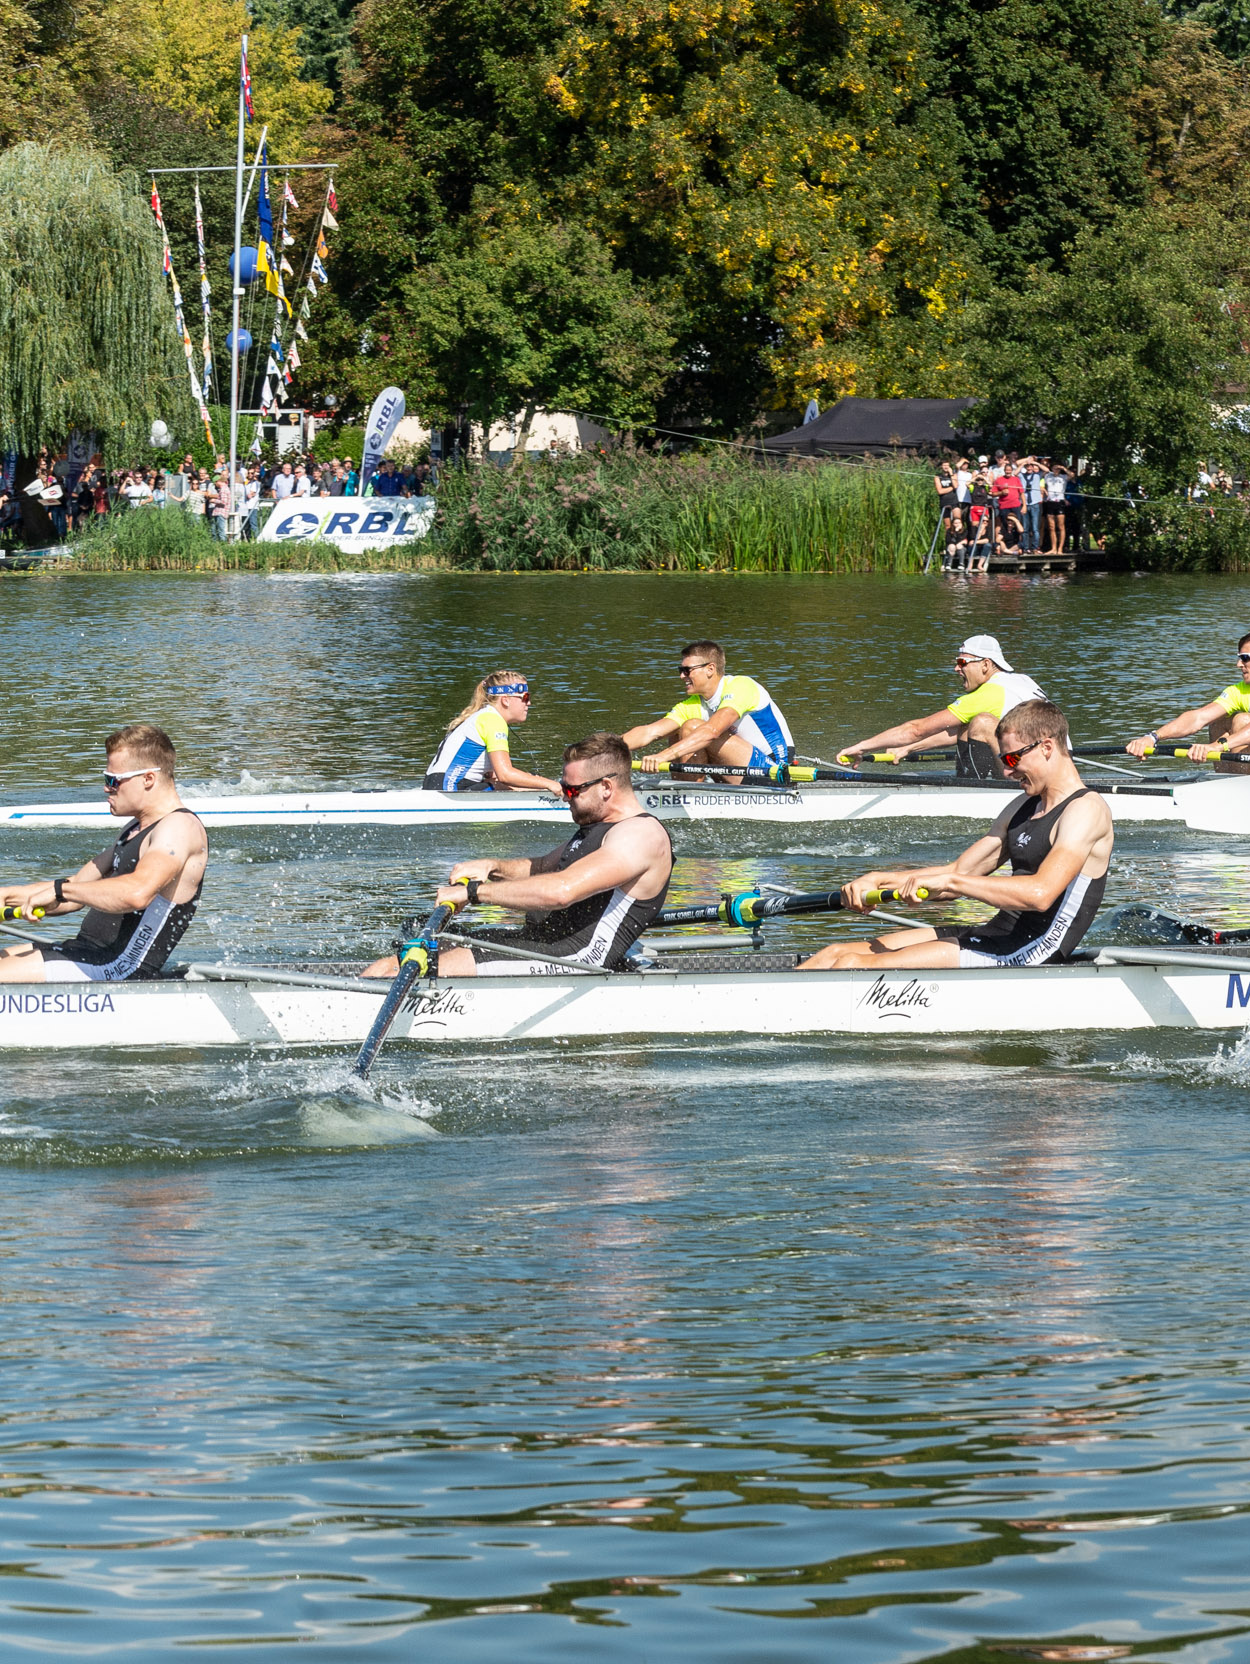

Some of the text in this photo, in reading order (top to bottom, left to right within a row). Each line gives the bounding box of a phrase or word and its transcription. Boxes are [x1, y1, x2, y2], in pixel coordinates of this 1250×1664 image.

[376, 397, 397, 431] RBL
[324, 512, 418, 535] RBL
[662, 795, 691, 805] RBL
[694, 795, 804, 806] RUDER-BUNDESLIGA
[856, 974, 933, 1009] Melitta
